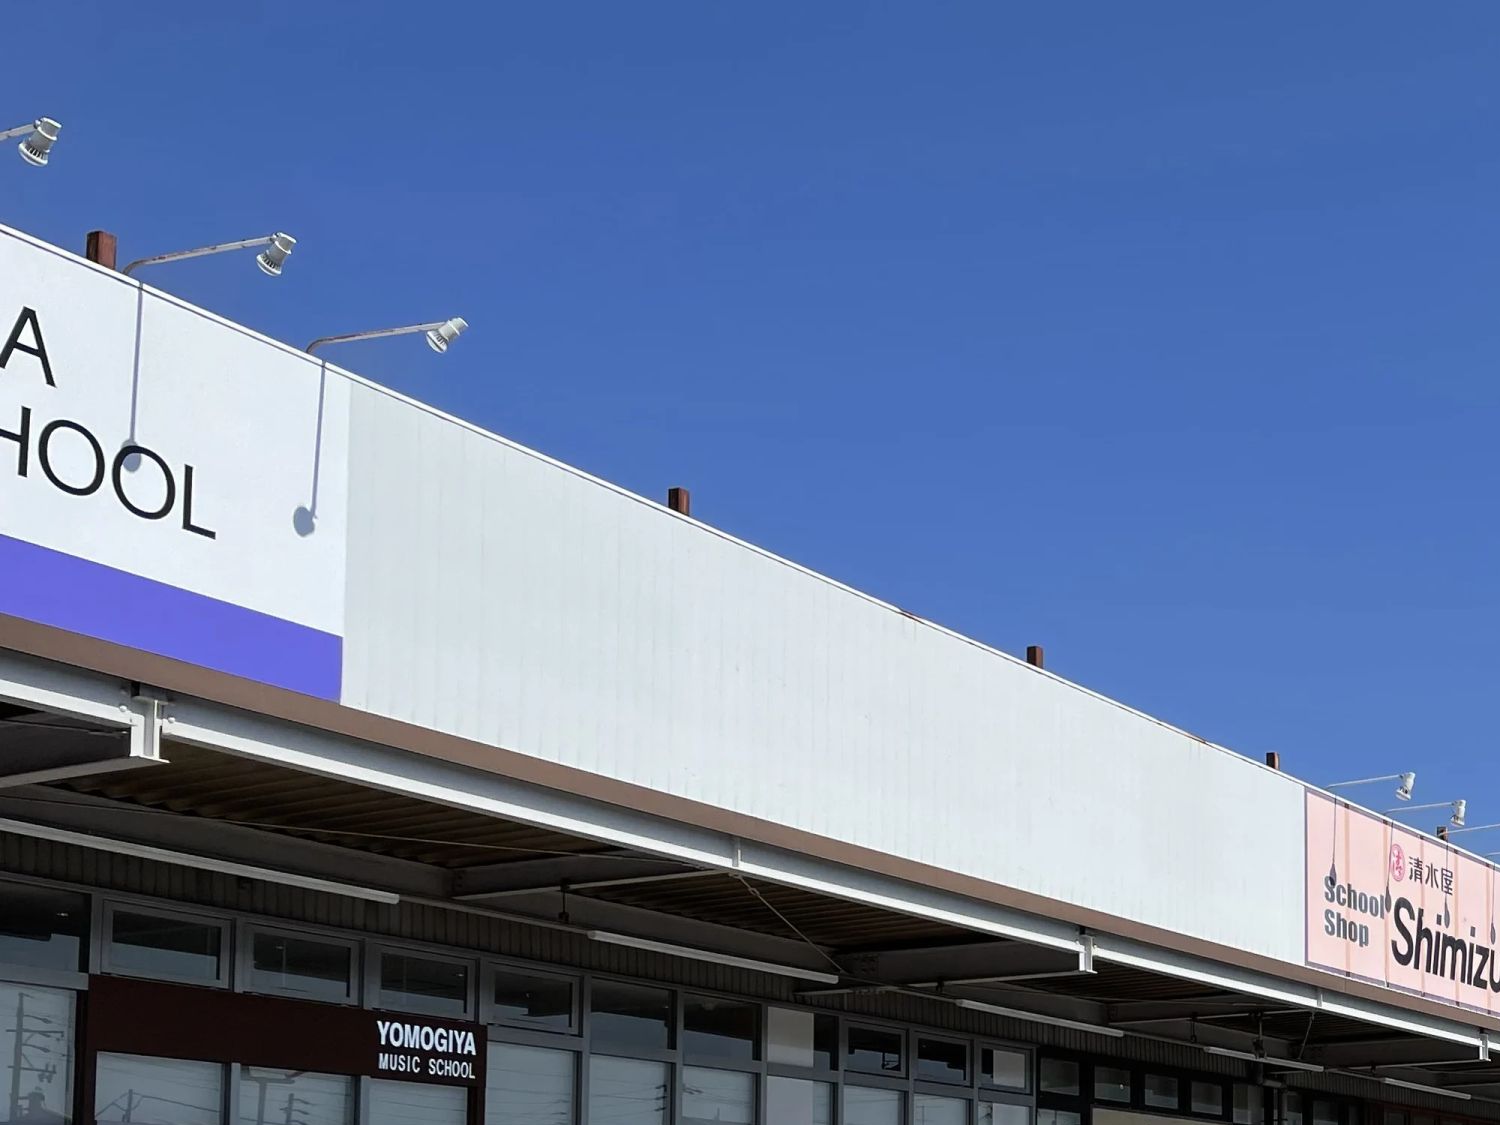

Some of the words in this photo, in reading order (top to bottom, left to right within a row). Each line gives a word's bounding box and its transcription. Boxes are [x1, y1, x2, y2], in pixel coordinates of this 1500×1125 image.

[0, 306, 57, 388] A
[1409, 856, 1453, 896] 清水屋
[1324, 875, 1384, 920] School
[1324, 908, 1369, 948] Shop
[377, 1021, 476, 1055] YOMOGIYA
[379, 1053, 420, 1073] MUSIC
[428, 1058, 476, 1079] SCHOOL
